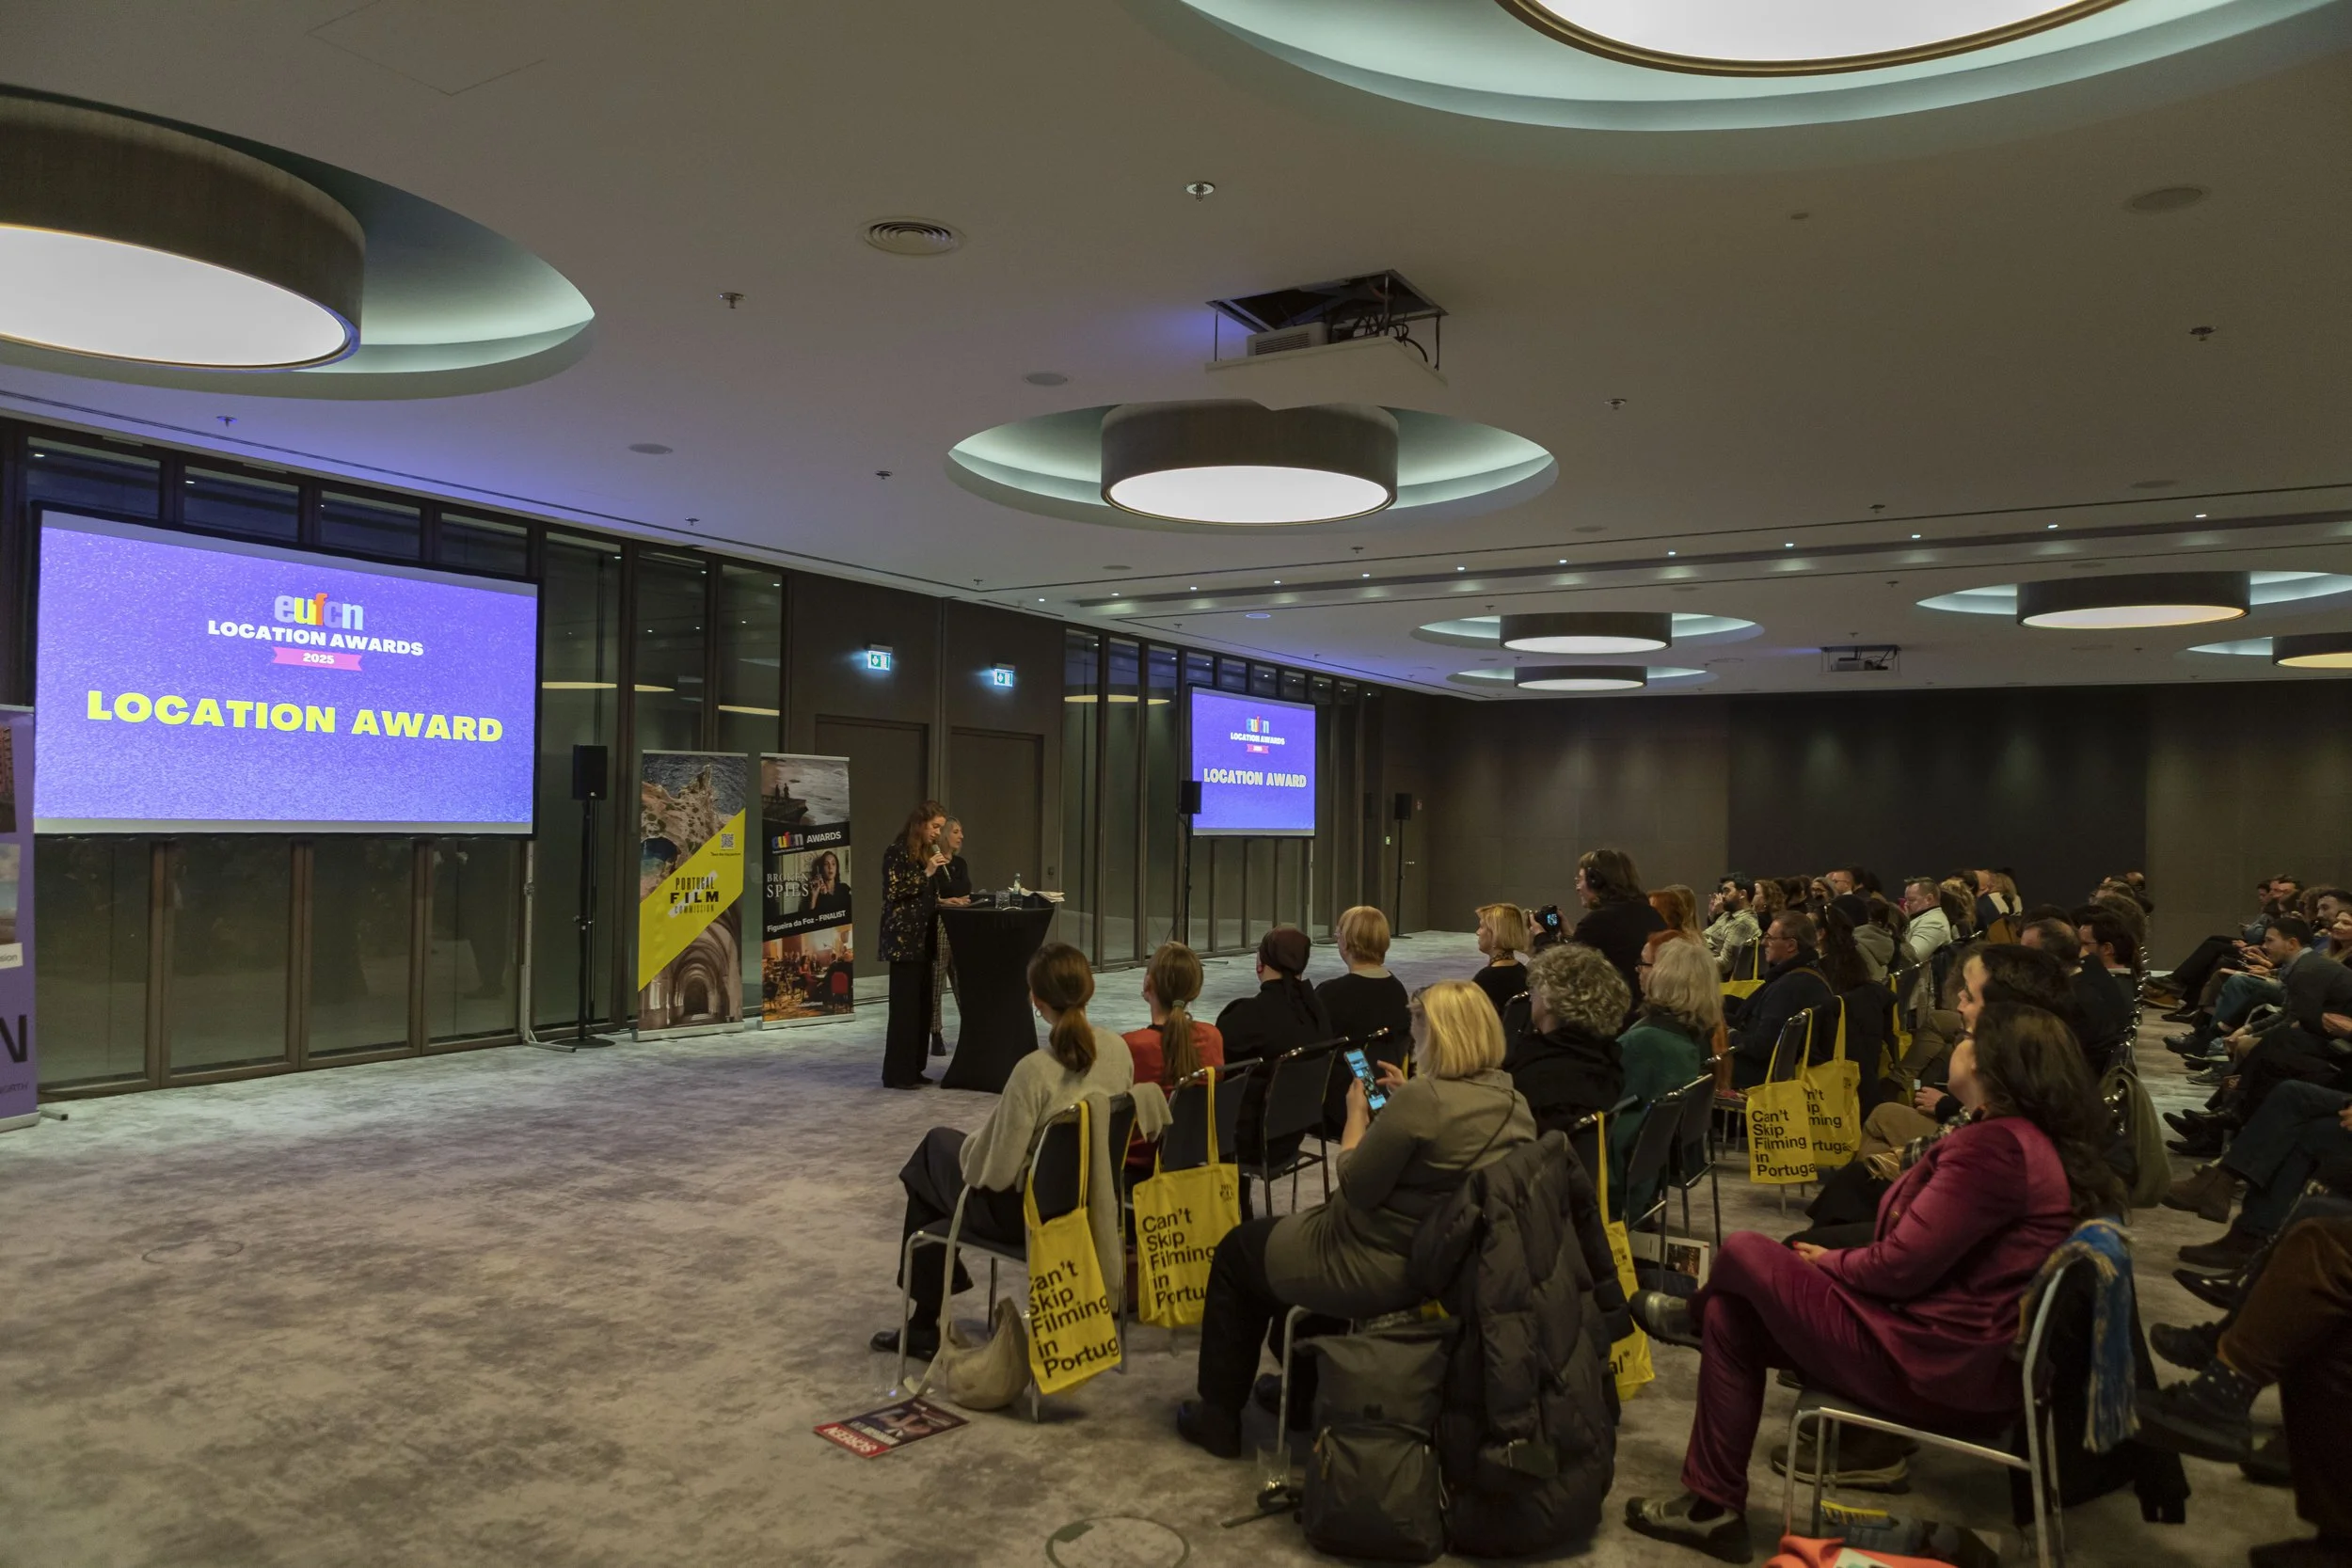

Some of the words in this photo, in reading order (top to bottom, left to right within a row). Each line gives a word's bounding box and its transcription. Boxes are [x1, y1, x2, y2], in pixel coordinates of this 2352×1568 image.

[275, 593, 363, 630] eufcn
[208, 620, 326, 646] LOCATION
[330, 634, 423, 656] AWARDS
[303, 653, 334, 664] 2025
[87, 690, 335, 733] LOCATION
[352, 710, 502, 742] AWARD
[1231, 732, 1260, 742] LOCATION
[1203, 768, 1263, 785] LOCATION
[1266, 772, 1307, 788] AWARD
[806, 832, 841, 843] AWARDS
[675, 877, 714, 890] PORTUGAL
[767, 873, 809, 882] BROKEN
[670, 891, 719, 904] FILM
[767, 883, 809, 898] SPIES
[675, 904, 714, 913] COMMISSION
[767, 922, 793, 932] Figueira
[818, 911, 846, 922] FINALIST
[1807, 1089, 1824, 1101] n't
[1752, 1109, 1789, 1123] Can't
[1808, 1117, 1841, 1129] ming
[1753, 1124, 1784, 1138] Skip
[1755, 1136, 1806, 1150] Filming
[1756, 1151, 1769, 1163] in
[1756, 1164, 1816, 1177] Portuga
[1142, 1208, 1192, 1233] Can't
[1147, 1229, 1184, 1252] Skip
[1150, 1245, 1216, 1271] Filming
[1153, 1273, 1169, 1291] in
[1029, 1287, 1073, 1316] Skip
[1156, 1286, 1205, 1309] Portu
[1031, 1295, 1110, 1338] Filming
[1036, 1339, 1058, 1359] in
[1044, 1337, 1120, 1378] Portug
